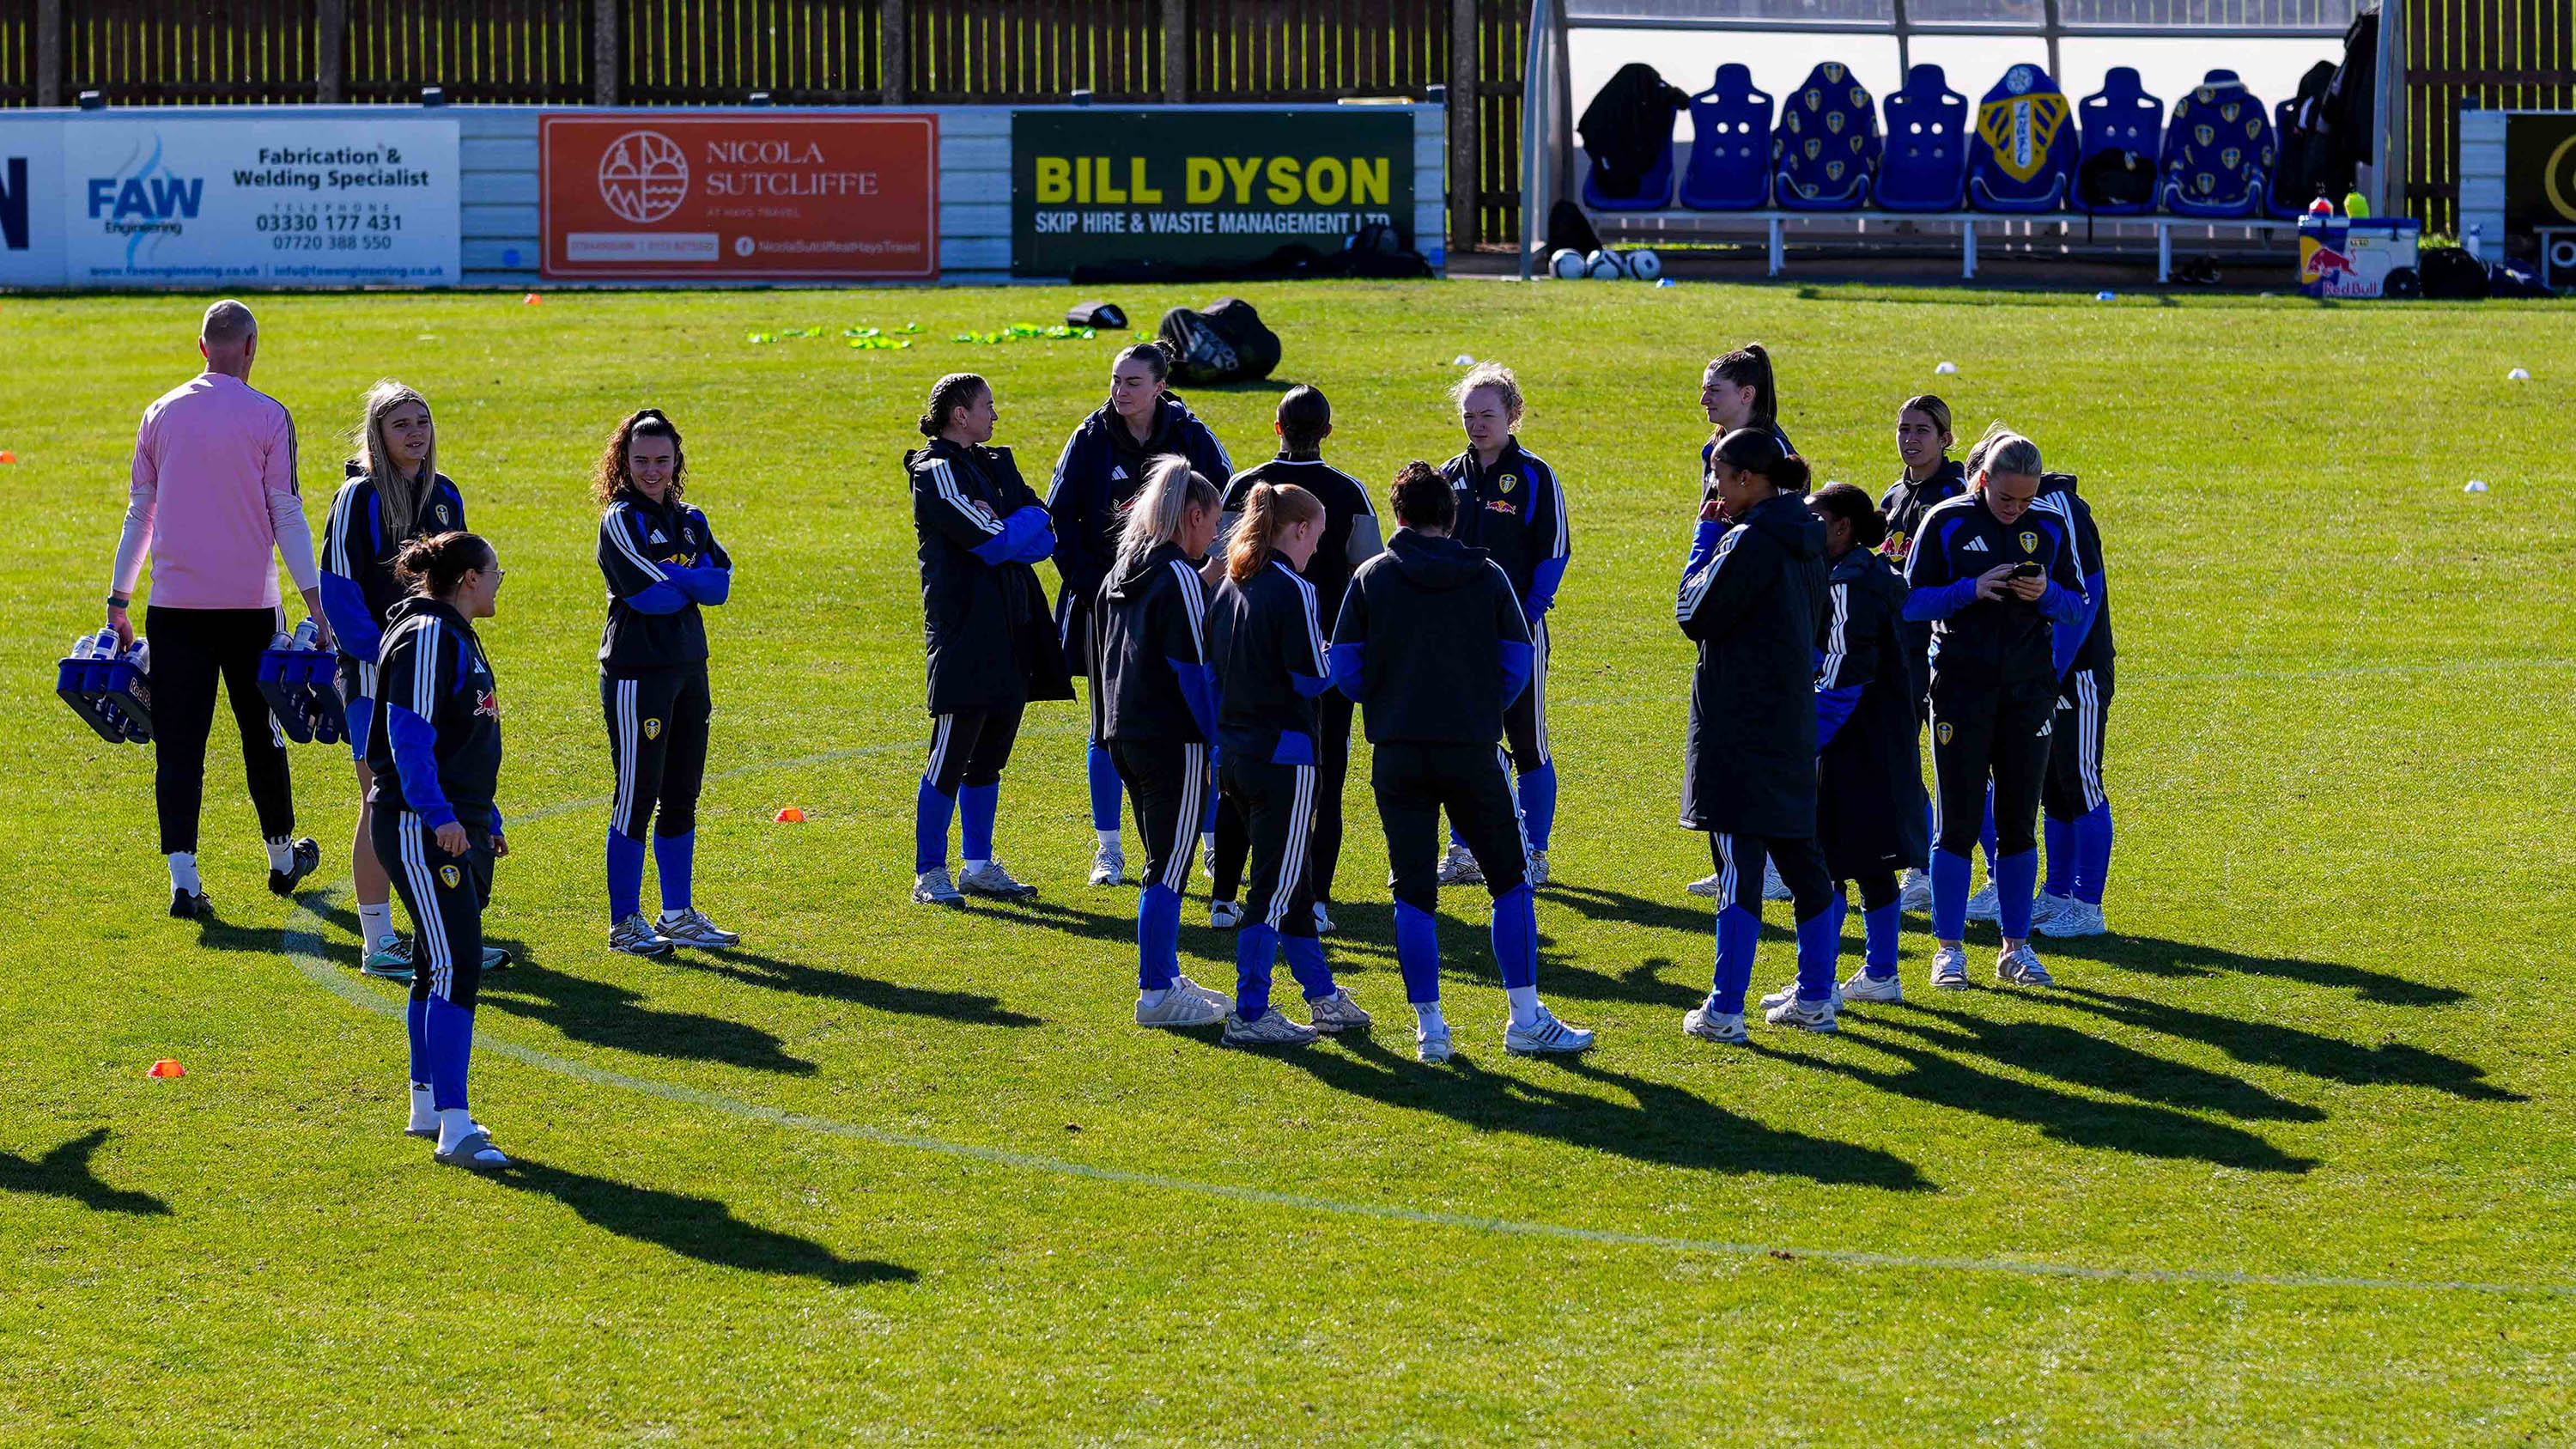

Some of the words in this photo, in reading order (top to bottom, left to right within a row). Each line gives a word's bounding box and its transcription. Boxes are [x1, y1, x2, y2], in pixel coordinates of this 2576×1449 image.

[258, 147, 380, 165] Fabrication
[386, 148, 401, 165] &
[706, 141, 824, 164] NICOLA
[233, 169, 321, 190] Welding
[327, 169, 429, 190] Specialist
[706, 173, 879, 196] SUTCLIFFE
[1036, 156, 1163, 204] BILL
[1186, 156, 1390, 205] DYSON
[88, 178, 204, 218] FAW
[104, 221, 183, 236] Engineering
[257, 215, 318, 231] 03330
[325, 215, 360, 231] 177
[368, 215, 402, 231] 431
[1035, 212, 1078, 234] SKIP
[1083, 212, 1126, 233] HIRE
[1130, 212, 1145, 234] &
[1148, 212, 1214, 234] WASTE
[1218, 212, 1351, 234] MANAGEMENT
[273, 234, 322, 250] 07720
[328, 234, 357, 250] 388
[362, 234, 392, 250] 550
[2324, 281, 2349, 295] Red
[2352, 281, 2377, 295] Bull
